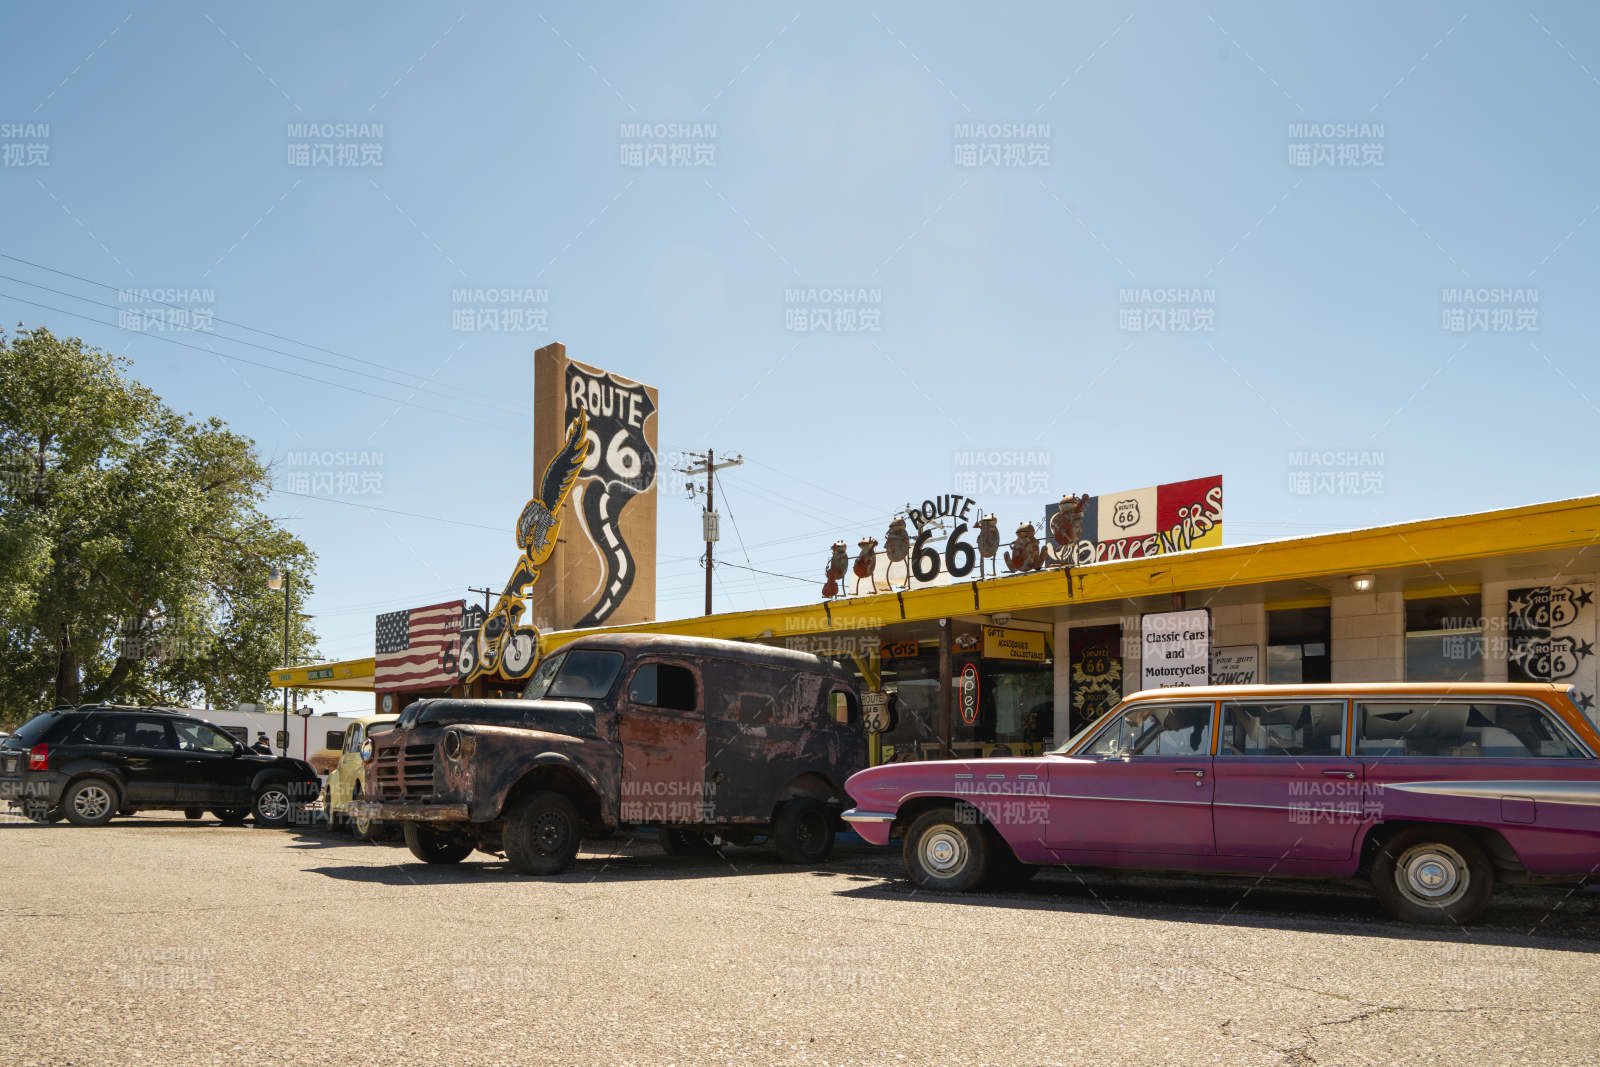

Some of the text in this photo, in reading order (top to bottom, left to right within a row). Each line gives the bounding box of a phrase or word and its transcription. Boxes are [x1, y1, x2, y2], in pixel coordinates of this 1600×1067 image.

[571, 376, 643, 428] ROUTE
[909, 495, 976, 529] ROUTE
[1119, 510, 1134, 523] 66
[911, 523, 976, 582] 66
[1535, 593, 1566, 604] ROUTE
[1536, 605, 1564, 623] 66
[1146, 631, 1205, 643] Classic Cars
[443, 635, 474, 675] 66
[882, 643, 915, 656] TOYS
[1165, 648, 1184, 659] and
[1535, 644, 1568, 654] ROUTE
[1087, 659, 1105, 673] 66
[1145, 665, 1206, 678] Motorcycles
[1537, 656, 1566, 674] 66
[861, 696, 885, 704] ROUTE
[864, 713, 881, 729] 66
